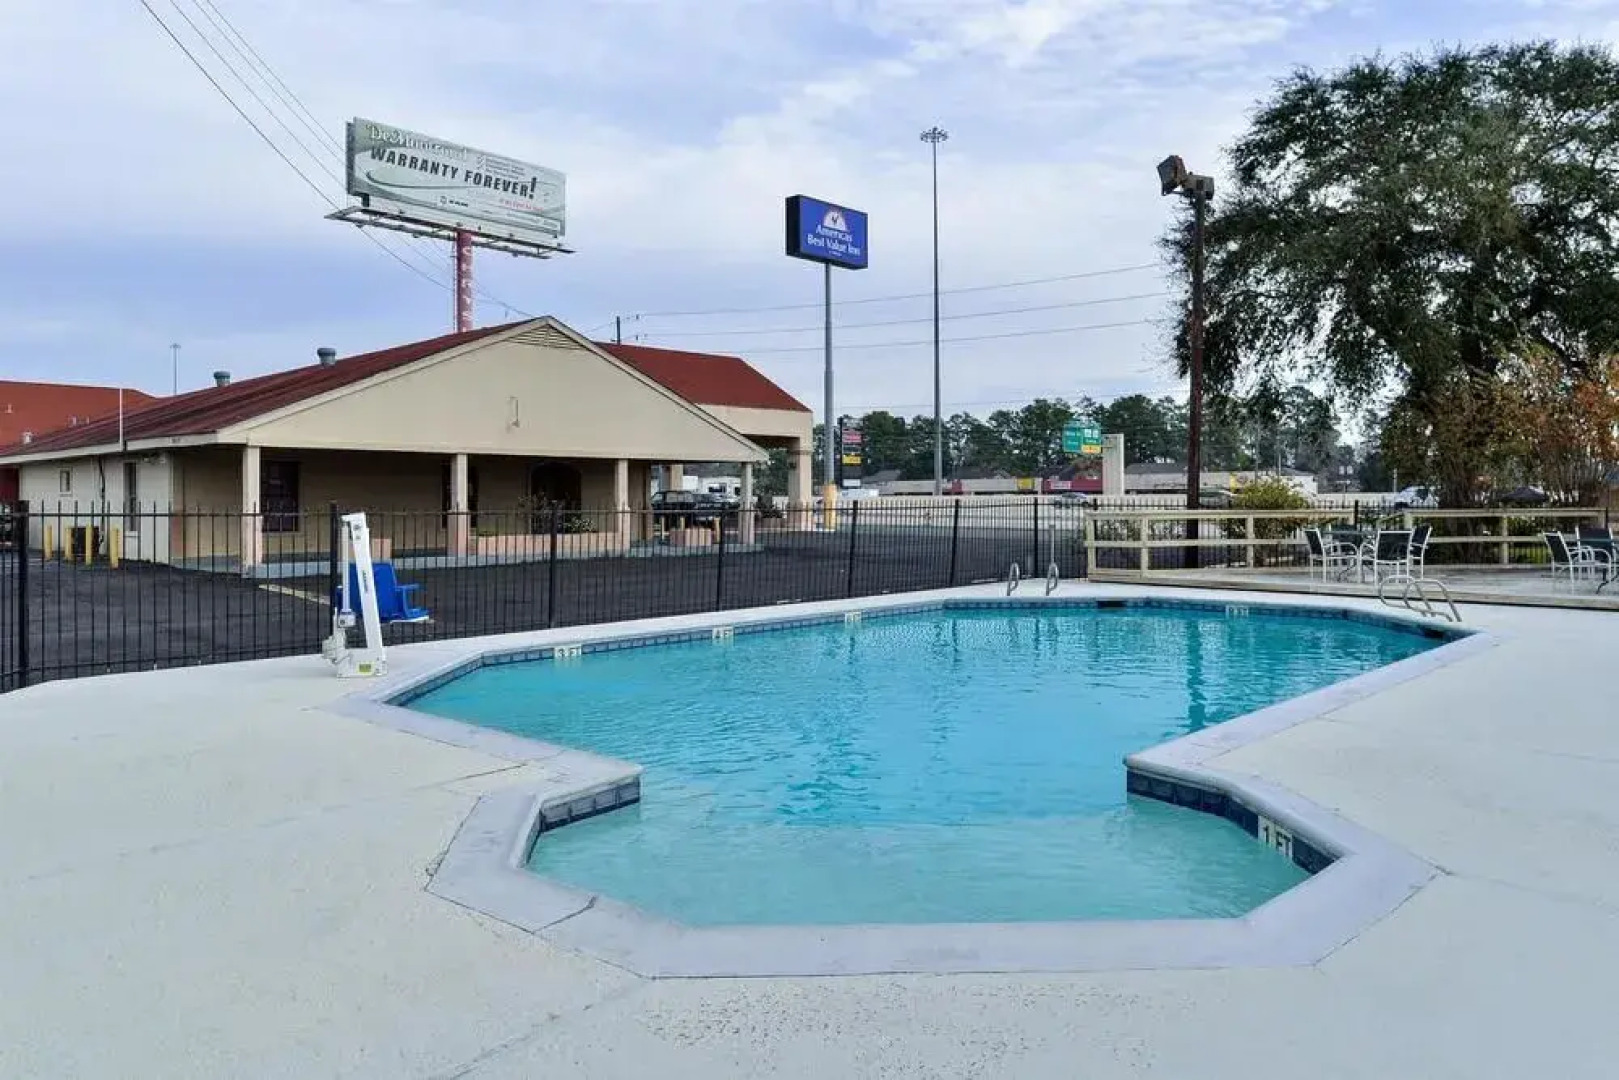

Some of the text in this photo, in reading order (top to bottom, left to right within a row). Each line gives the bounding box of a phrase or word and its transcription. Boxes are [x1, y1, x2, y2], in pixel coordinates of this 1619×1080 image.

[370, 147, 459, 179] WARRANTY
[464, 169, 538, 199] FOREVER!
[807, 233, 825, 247] Best
[826, 237, 848, 253] Value
[848, 243, 861, 256] Inn
[1262, 824, 1292, 857] 1 FT
